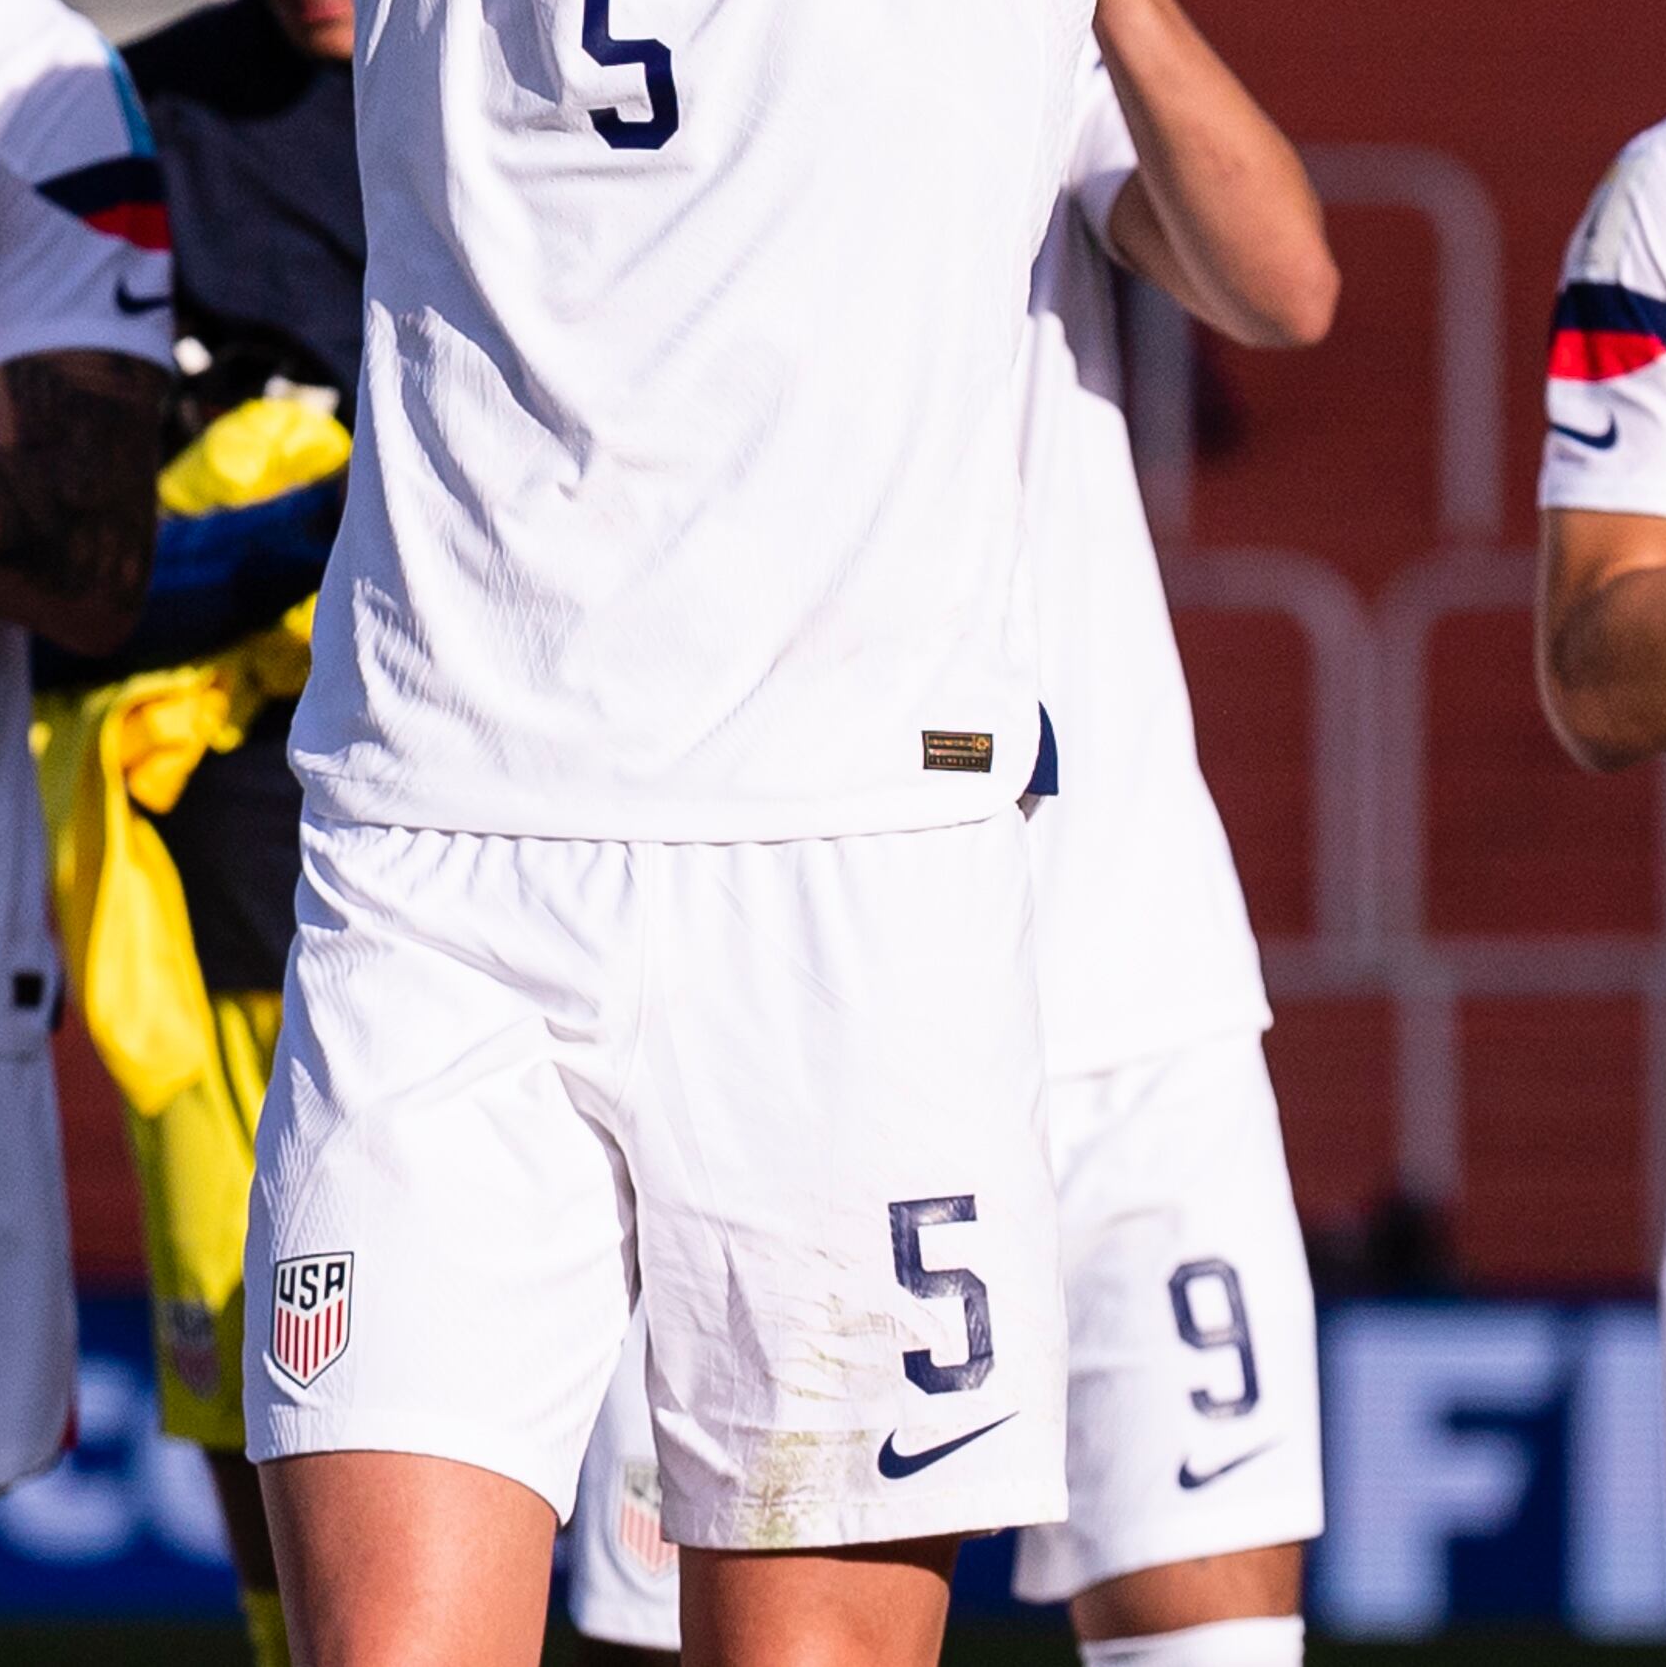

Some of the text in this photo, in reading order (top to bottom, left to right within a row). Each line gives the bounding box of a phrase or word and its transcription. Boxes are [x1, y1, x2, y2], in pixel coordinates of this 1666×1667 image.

[279, 1261, 347, 1312] USA
[888, 1194, 995, 1395] 5
[1167, 1257, 1260, 1420] 9
